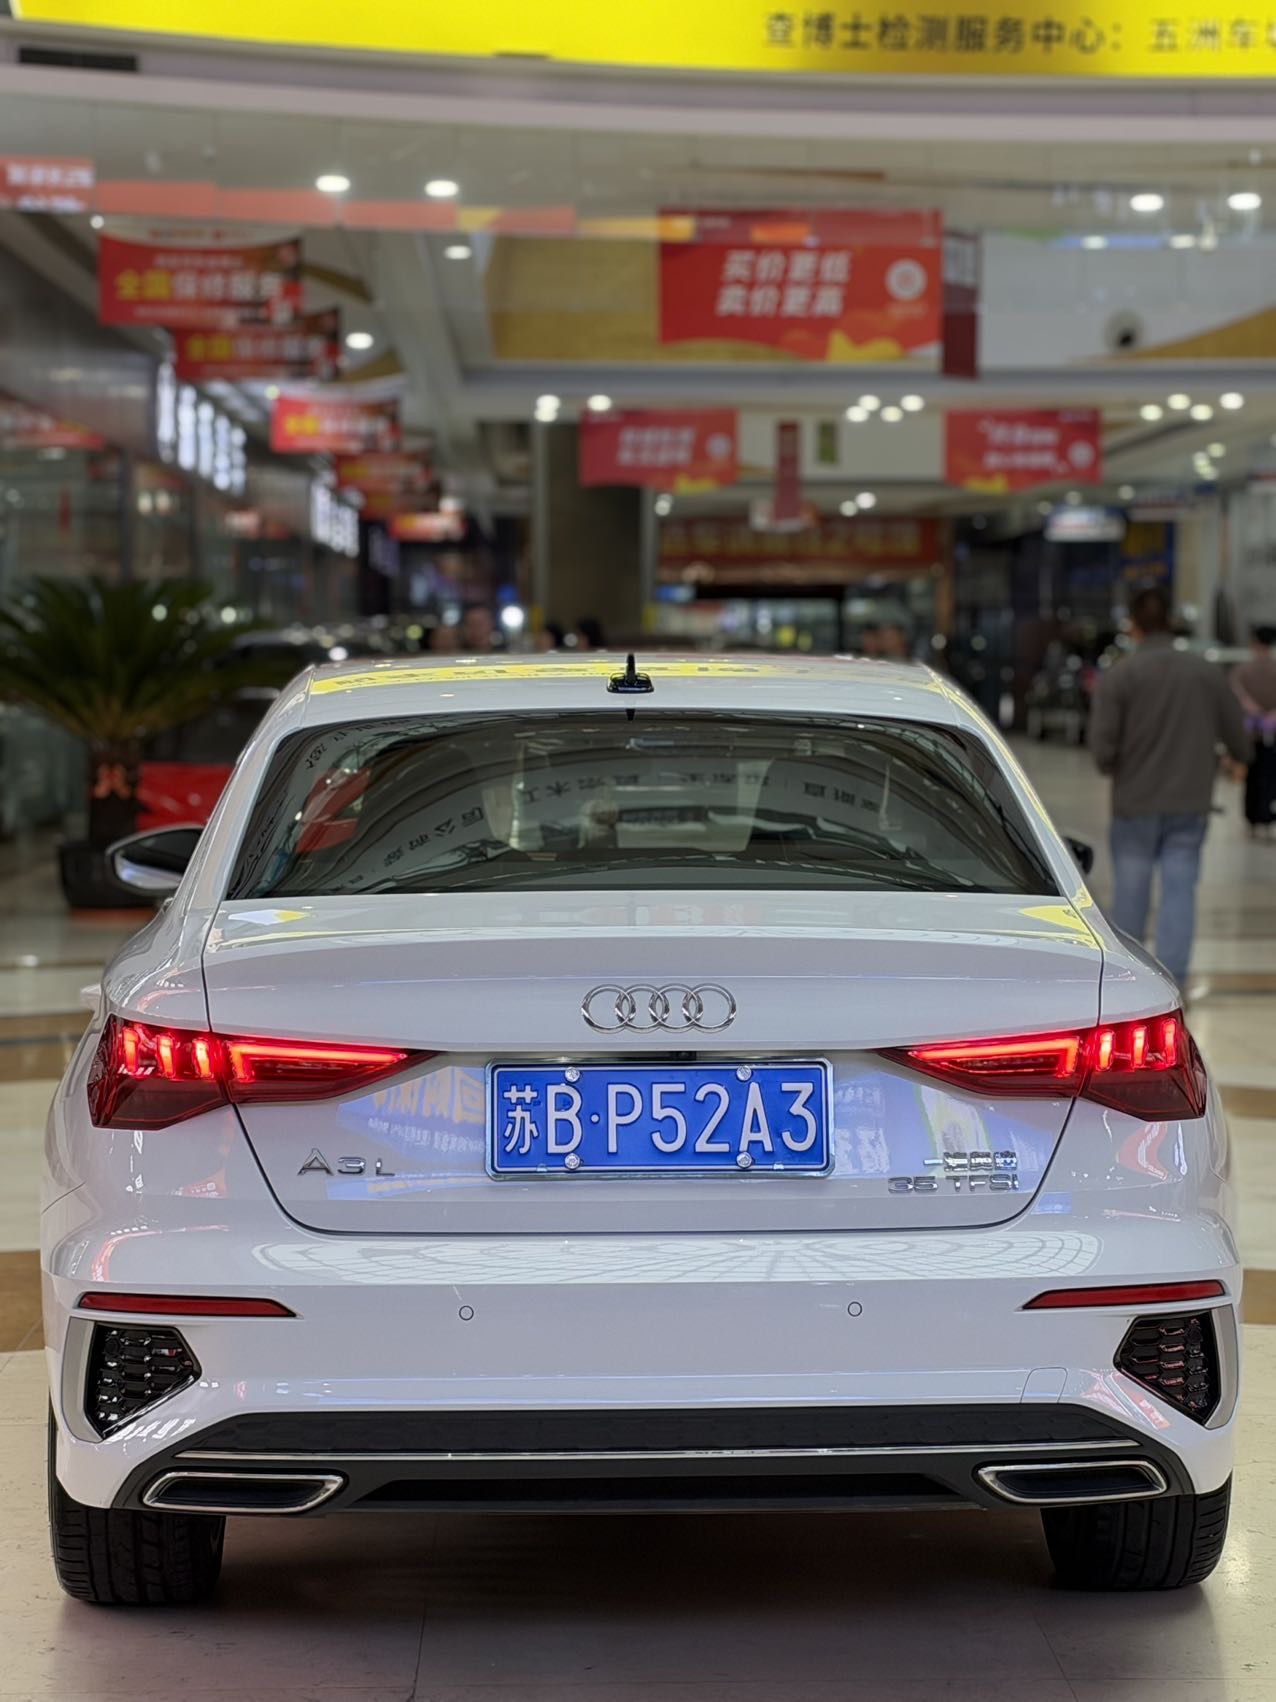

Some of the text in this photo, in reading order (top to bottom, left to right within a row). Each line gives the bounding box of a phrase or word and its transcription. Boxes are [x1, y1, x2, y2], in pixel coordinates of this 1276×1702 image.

[502, 1082, 818, 1155] 苏B·P52A3
[888, 1173, 1019, 1193] 35 TFSI
